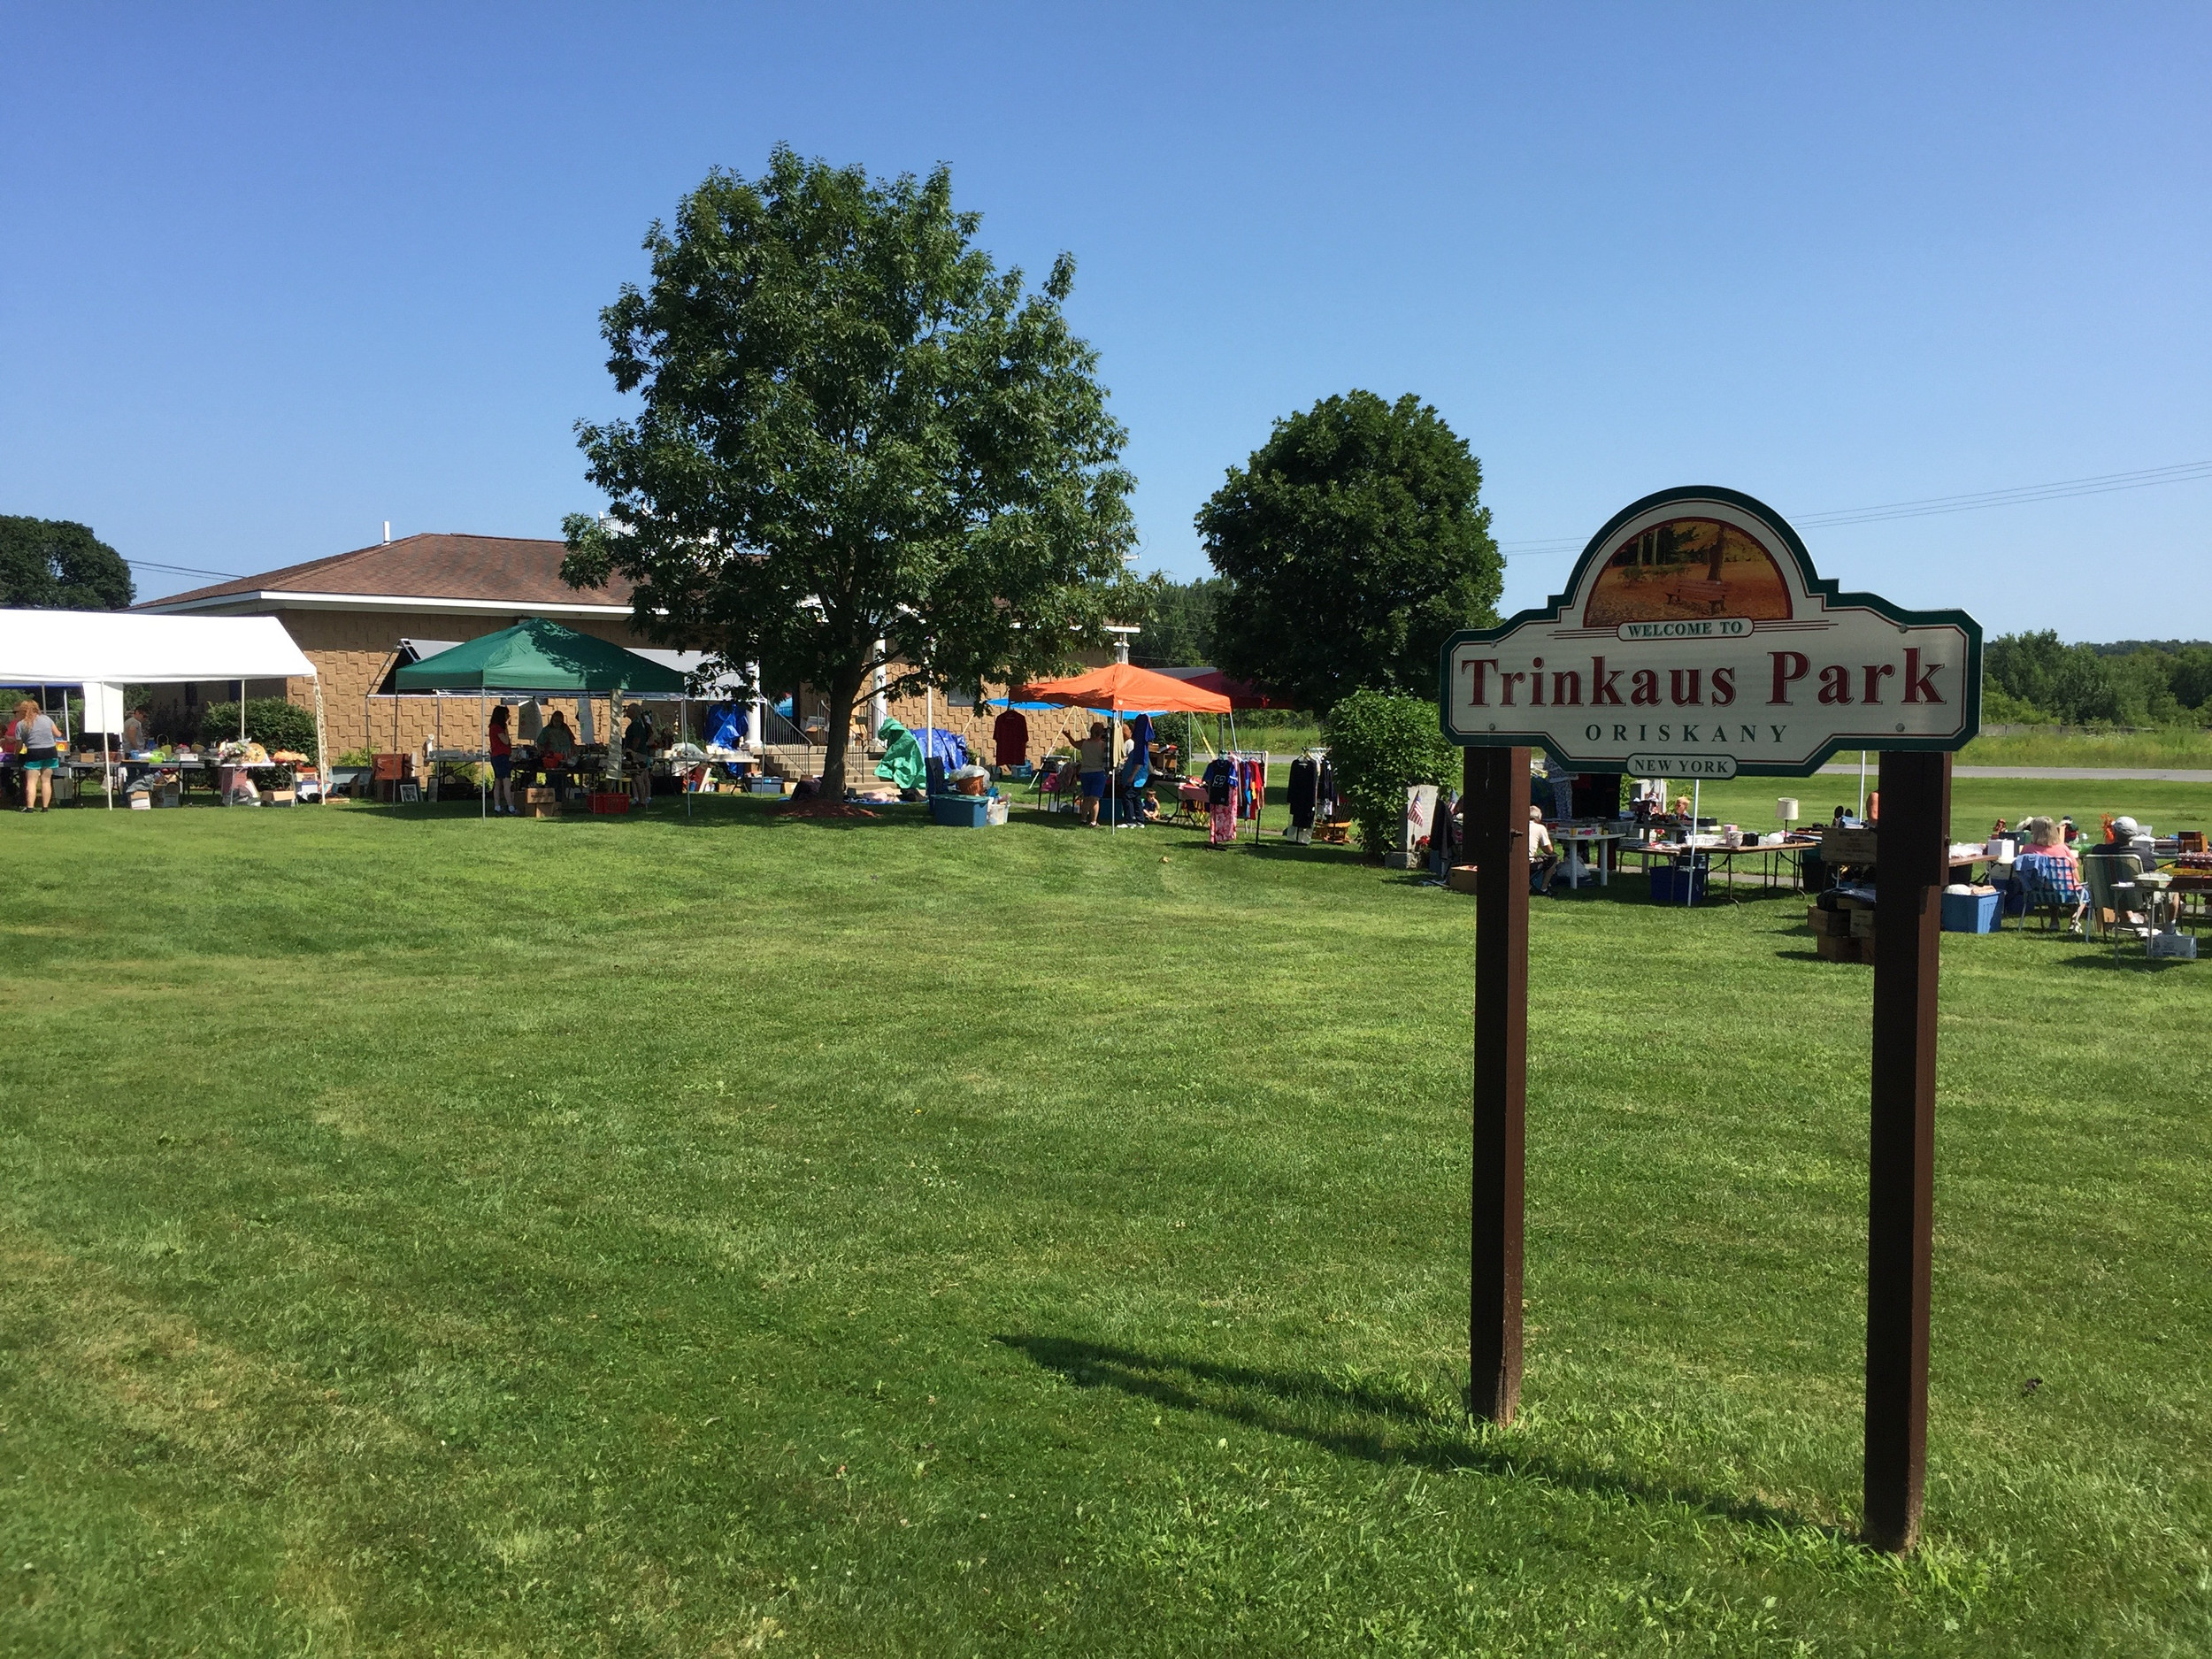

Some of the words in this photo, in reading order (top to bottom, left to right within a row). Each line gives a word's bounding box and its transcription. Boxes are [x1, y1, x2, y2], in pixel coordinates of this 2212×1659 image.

[1628, 622, 1712, 637] WELCOME
[1720, 621, 1743, 634] TO
[1462, 656, 1736, 707] Trinkaus
[1765, 647, 1947, 706] Park
[1586, 724, 1787, 743] ORISKANY
[1635, 759, 1672, 772] NEW
[1678, 760, 1729, 773] YORK
